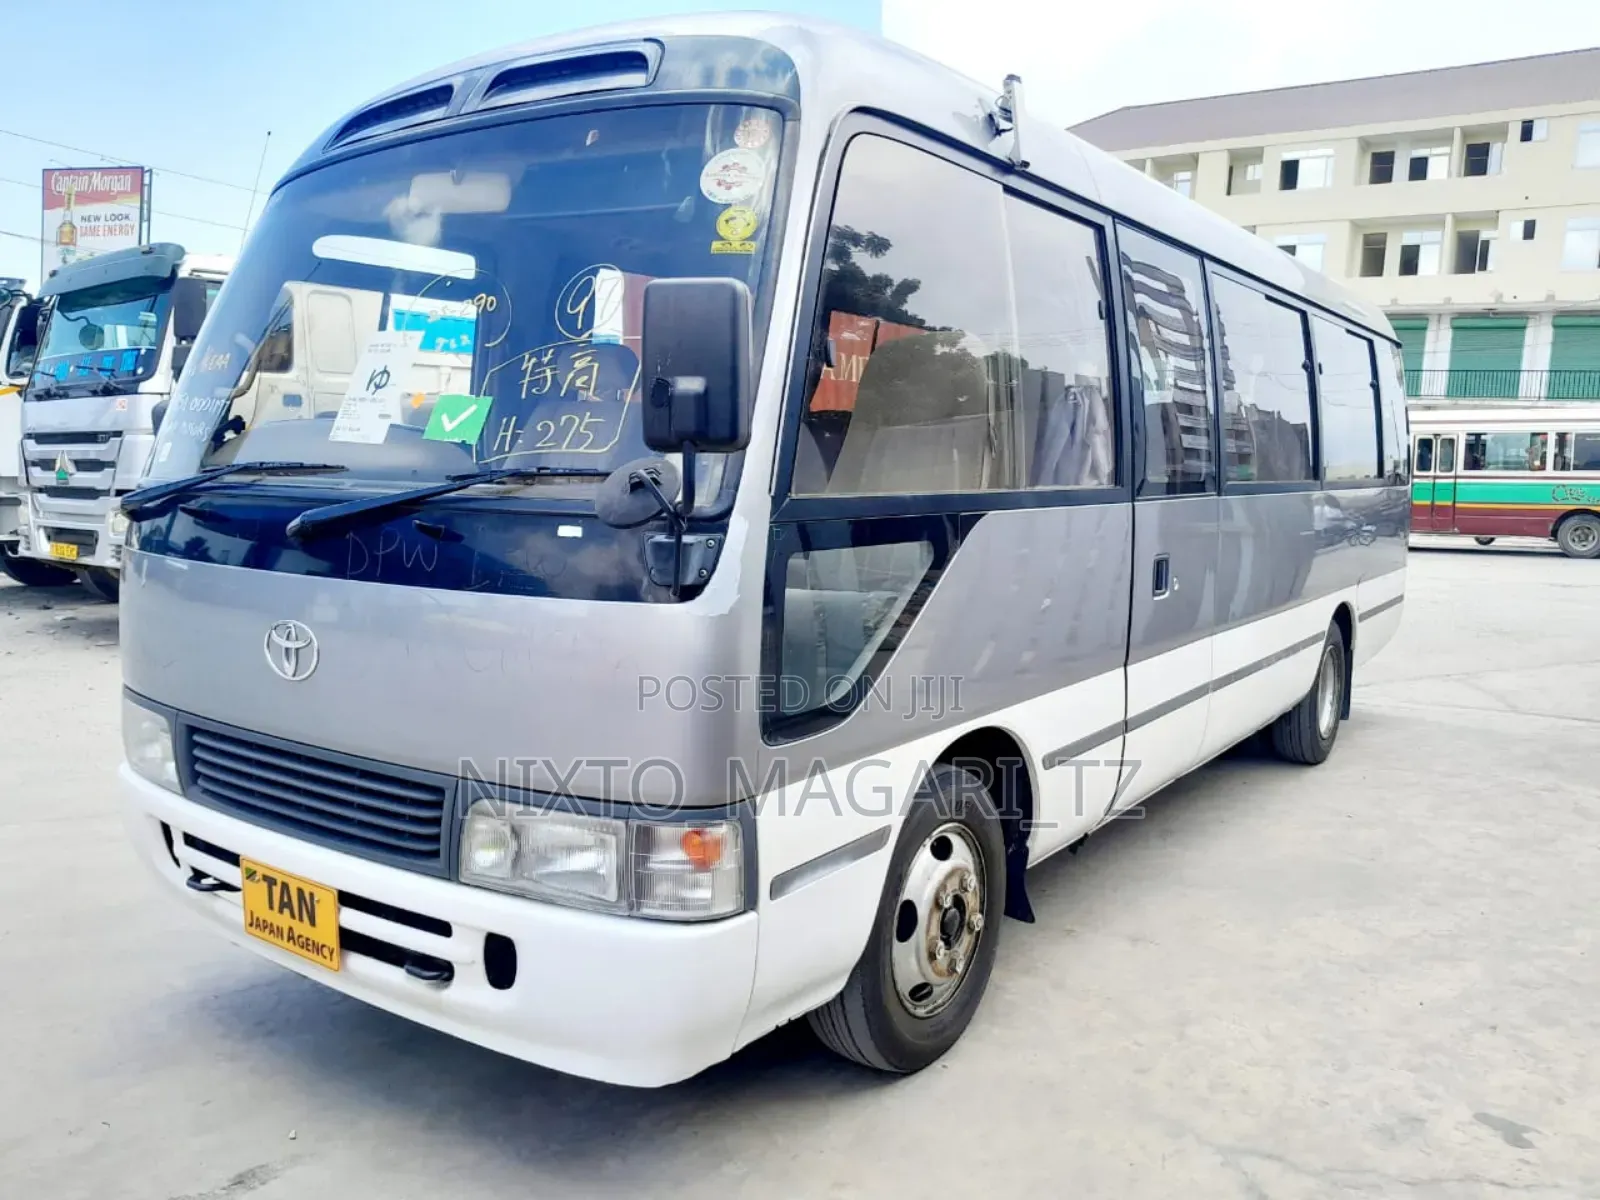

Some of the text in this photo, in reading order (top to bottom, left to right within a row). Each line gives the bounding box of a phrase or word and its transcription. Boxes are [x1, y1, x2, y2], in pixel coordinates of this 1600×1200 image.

[51, 171, 131, 195] Captain Morgan
[80, 213, 130, 222] NEW LOOK
[79, 224, 134, 236] SAME ENERGY
[535, 412, 606, 451] 275
[262, 874, 317, 928] TAN
